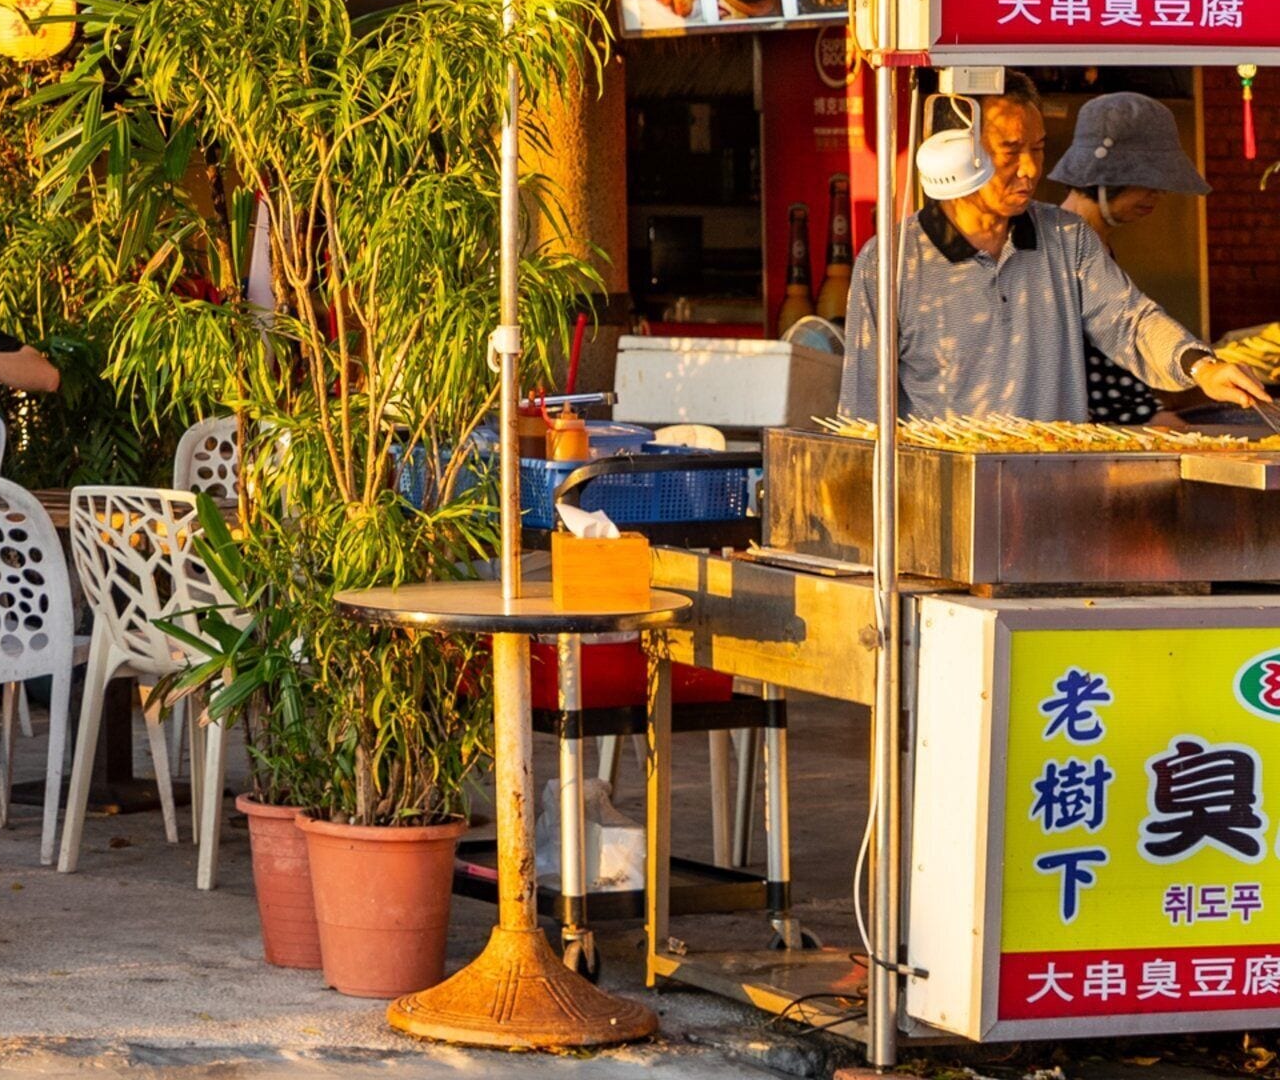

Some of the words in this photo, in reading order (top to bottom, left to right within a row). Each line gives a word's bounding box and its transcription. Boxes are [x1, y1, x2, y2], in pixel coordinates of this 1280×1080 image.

[1031, 668, 1113, 921] 老樹下
[1143, 740, 1264, 858] 臭
[1163, 883, 1262, 923] 취도푸
[1025, 953, 1280, 1004] 大串臭豆腐
